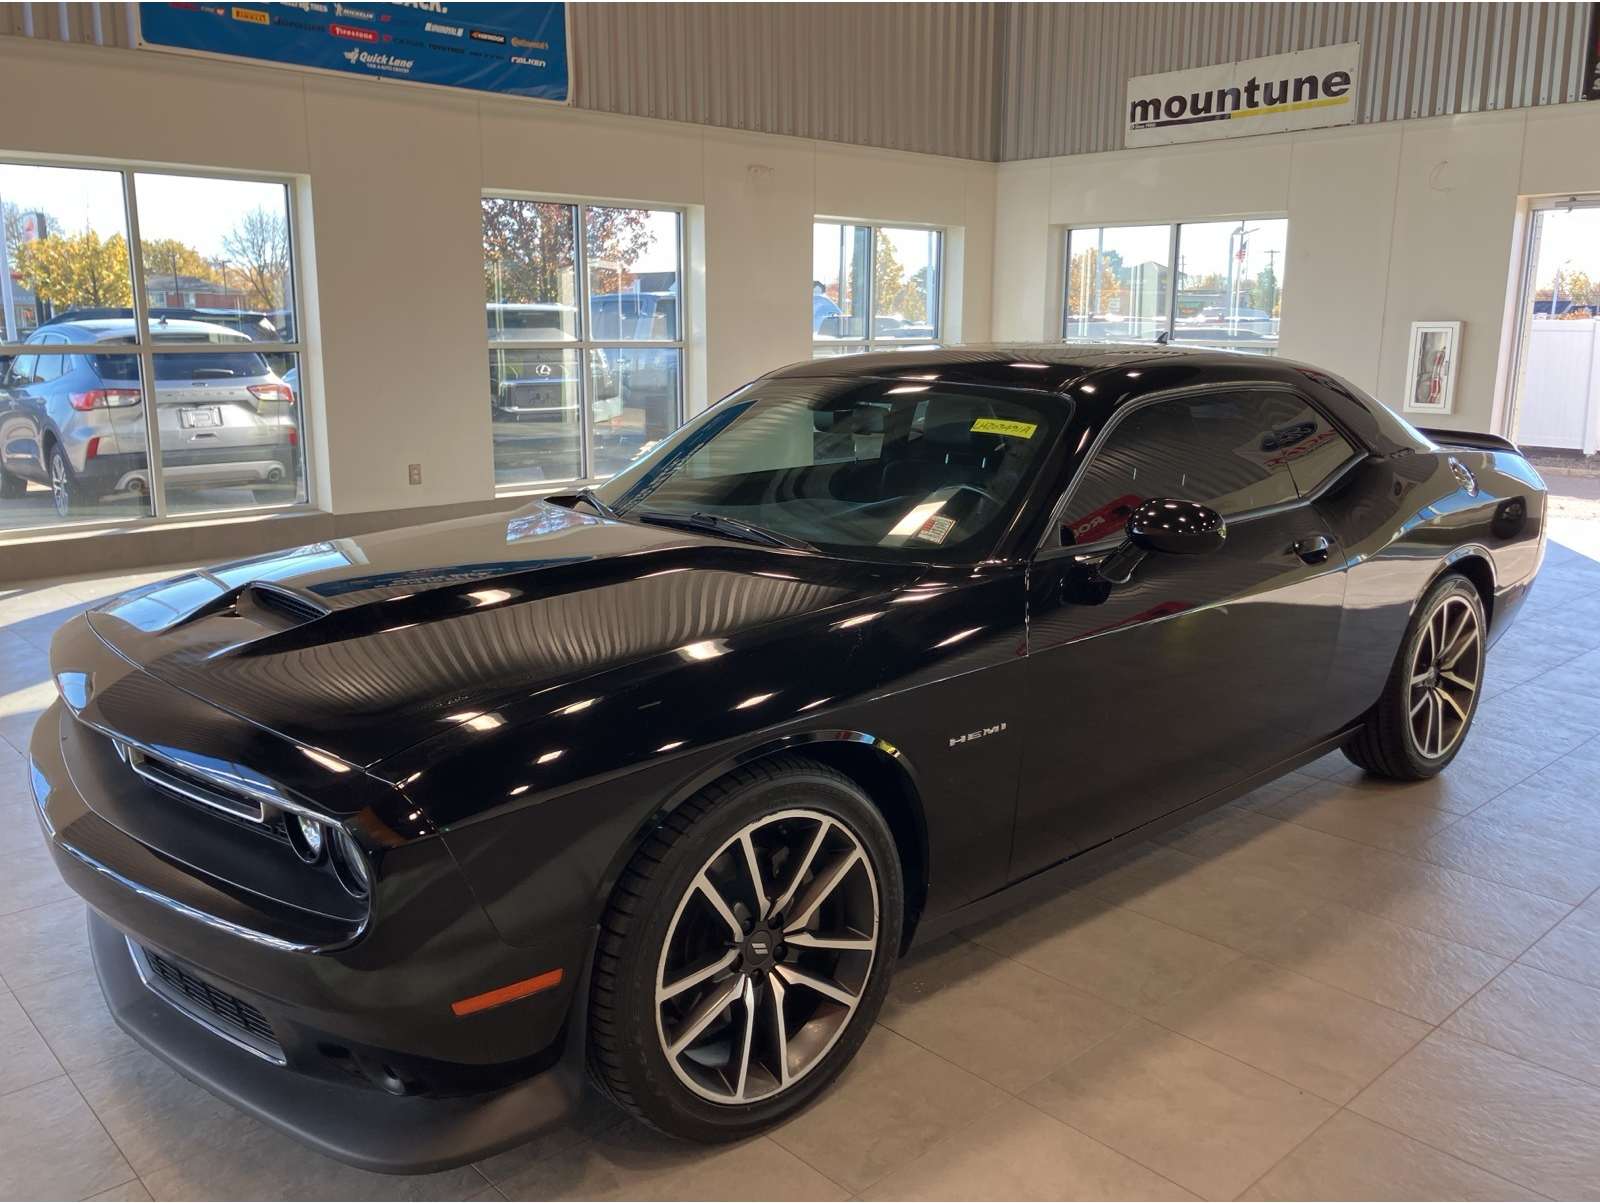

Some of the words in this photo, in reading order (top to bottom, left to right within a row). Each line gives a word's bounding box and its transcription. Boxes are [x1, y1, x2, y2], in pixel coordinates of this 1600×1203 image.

[359, 51, 388, 65] Quick
[388, 56, 415, 69] Lane
[1130, 70, 1350, 123] mountune
[949, 722, 1006, 747] HEMI
